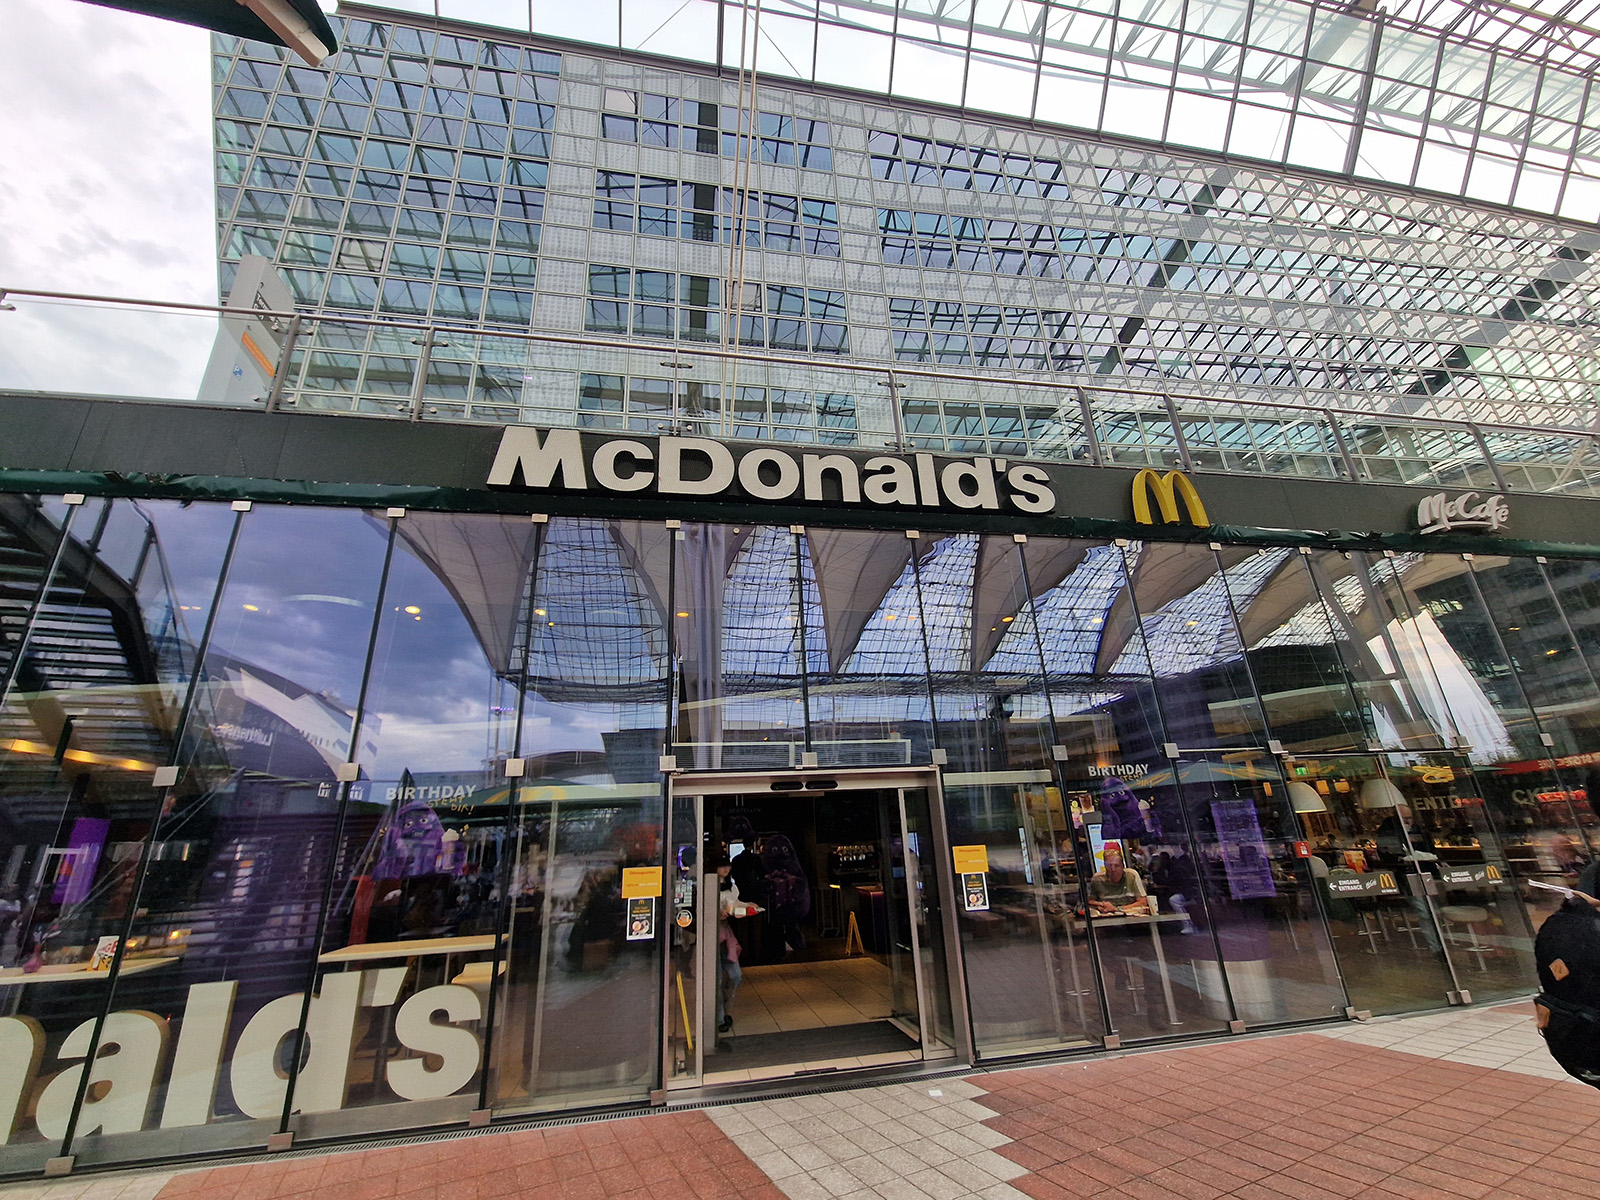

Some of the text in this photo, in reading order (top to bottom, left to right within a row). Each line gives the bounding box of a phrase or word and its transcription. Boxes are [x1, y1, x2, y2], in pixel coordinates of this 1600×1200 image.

[486, 426, 1057, 514] McDonald's
[1417, 491, 1510, 534] McCafé
[1087, 763, 1149, 777] BIRTHDAY
[385, 784, 477, 801] BIRTHDAY
[427, 795, 466, 808] STEHT
[1338, 884, 1363, 892] ENTRANCE
